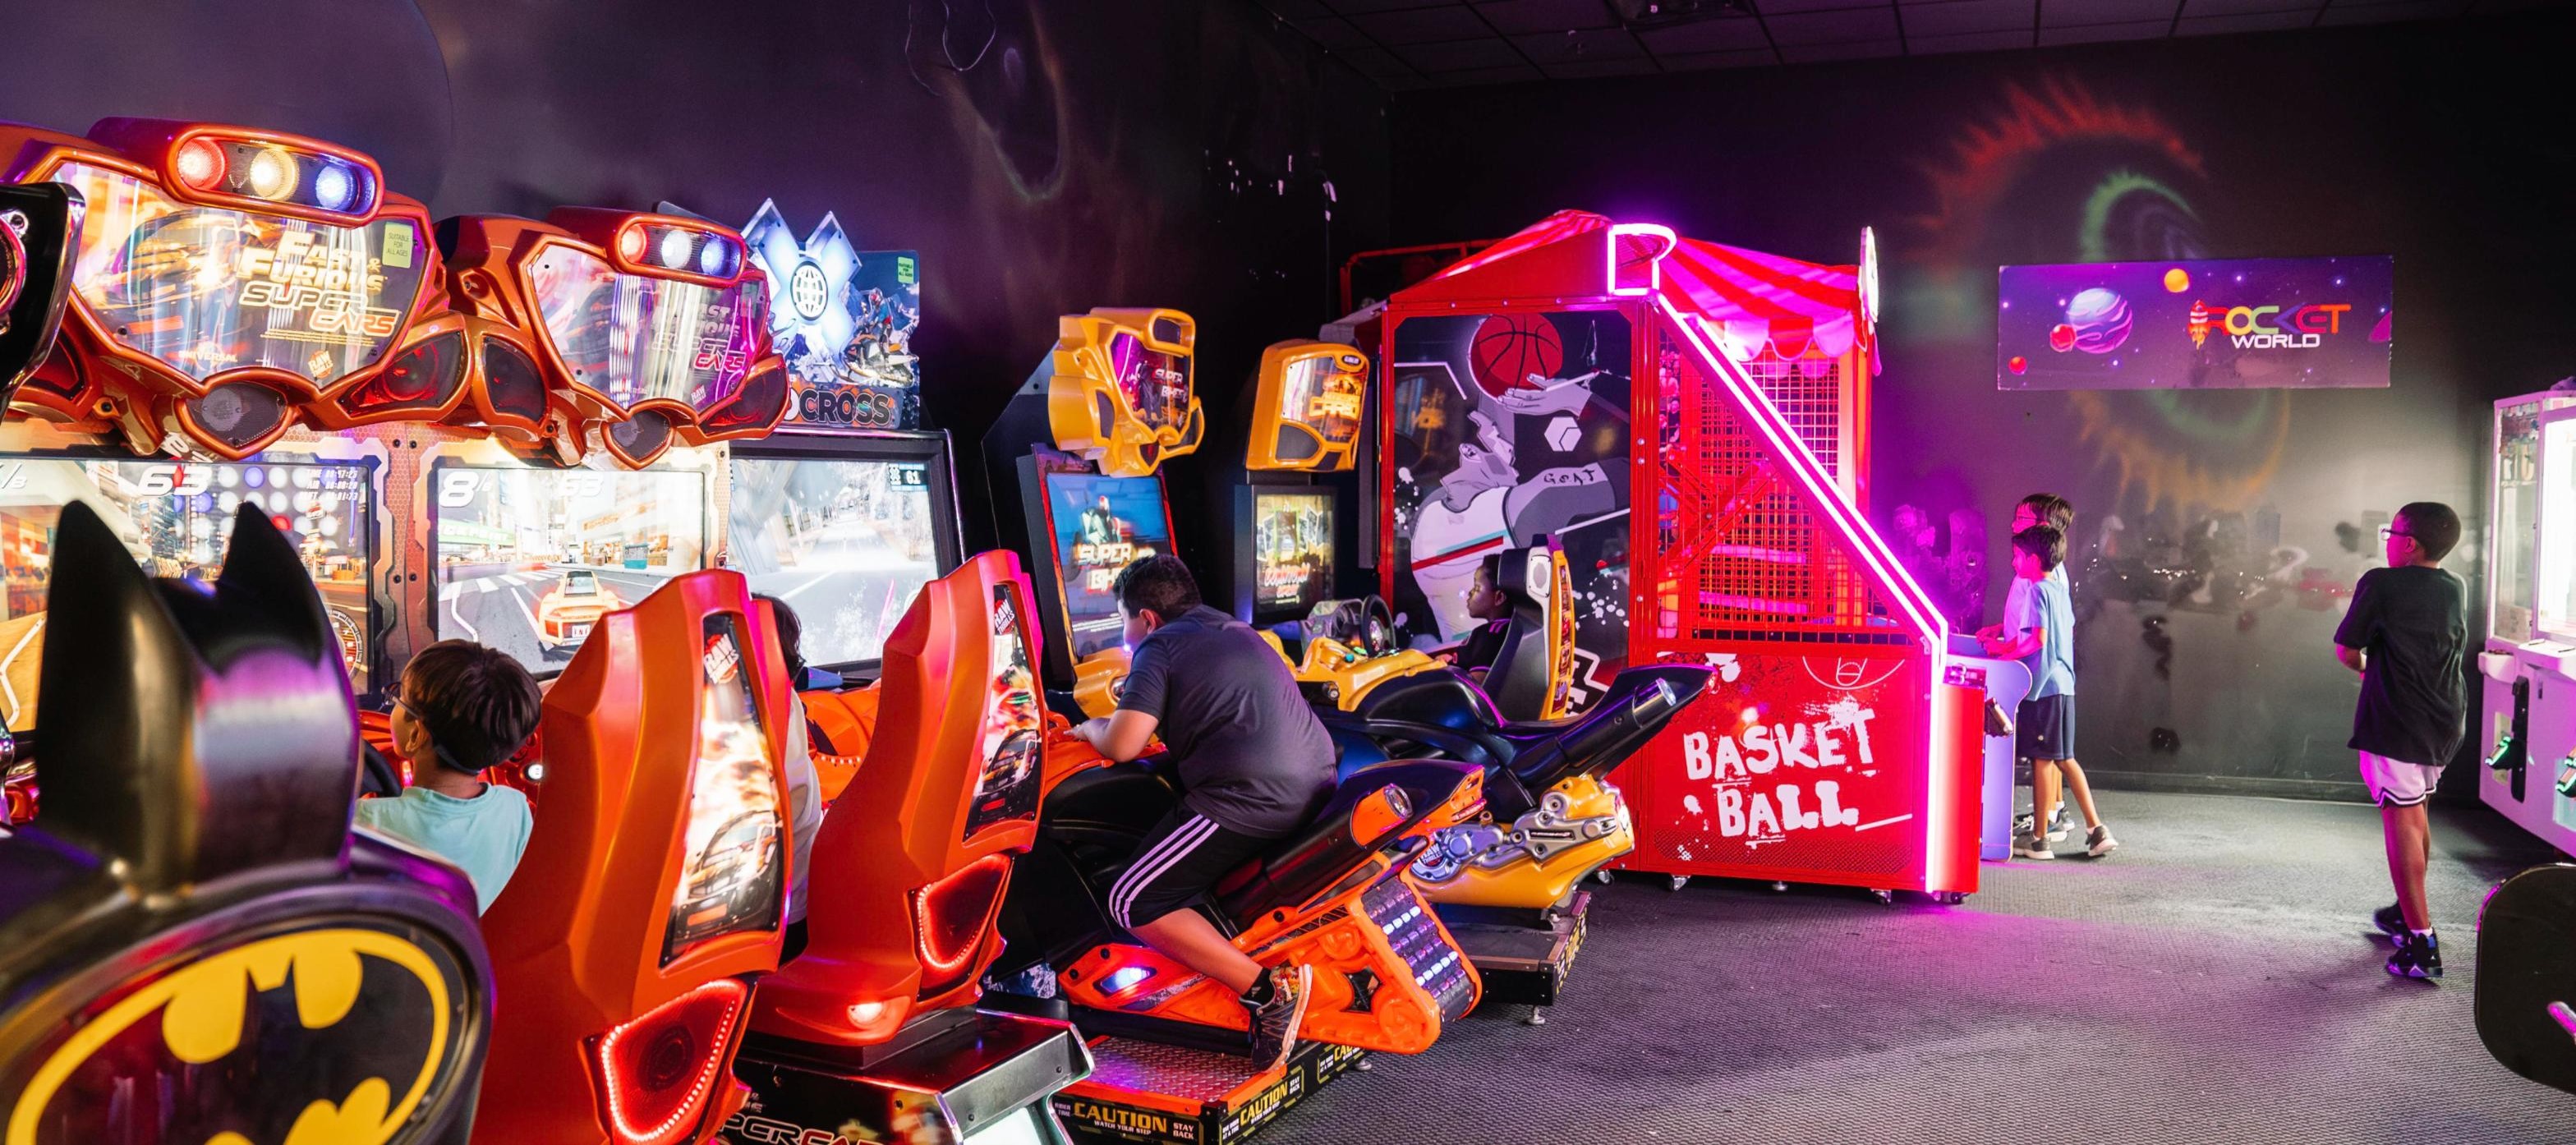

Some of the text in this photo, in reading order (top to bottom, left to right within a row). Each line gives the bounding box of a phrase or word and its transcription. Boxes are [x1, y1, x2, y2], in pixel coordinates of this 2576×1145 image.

[276, 231, 383, 274] FAST &
[236, 248, 384, 293] FURIOUS
[239, 281, 369, 312] SUPER
[309, 308, 400, 338] CARS
[2200, 302, 2352, 336] ROCKET
[2231, 333, 2321, 349] WORLD
[136, 465, 214, 497] 63
[1079, 543, 1133, 567] SUPER
[994, 599, 1012, 630] RAW
[703, 633, 734, 674] RAW
[1684, 708, 1876, 780] BASKET
[1715, 780, 1860, 838] BALL
[1074, 1102, 1167, 1134] CAUTION
[1240, 1081, 1288, 1127] CAUTION
[1094, 1120, 1152, 1136] WATCH YOUR STEP
[1173, 1122, 1194, 1133] STAY
[1173, 1129, 1194, 1140] BACK
